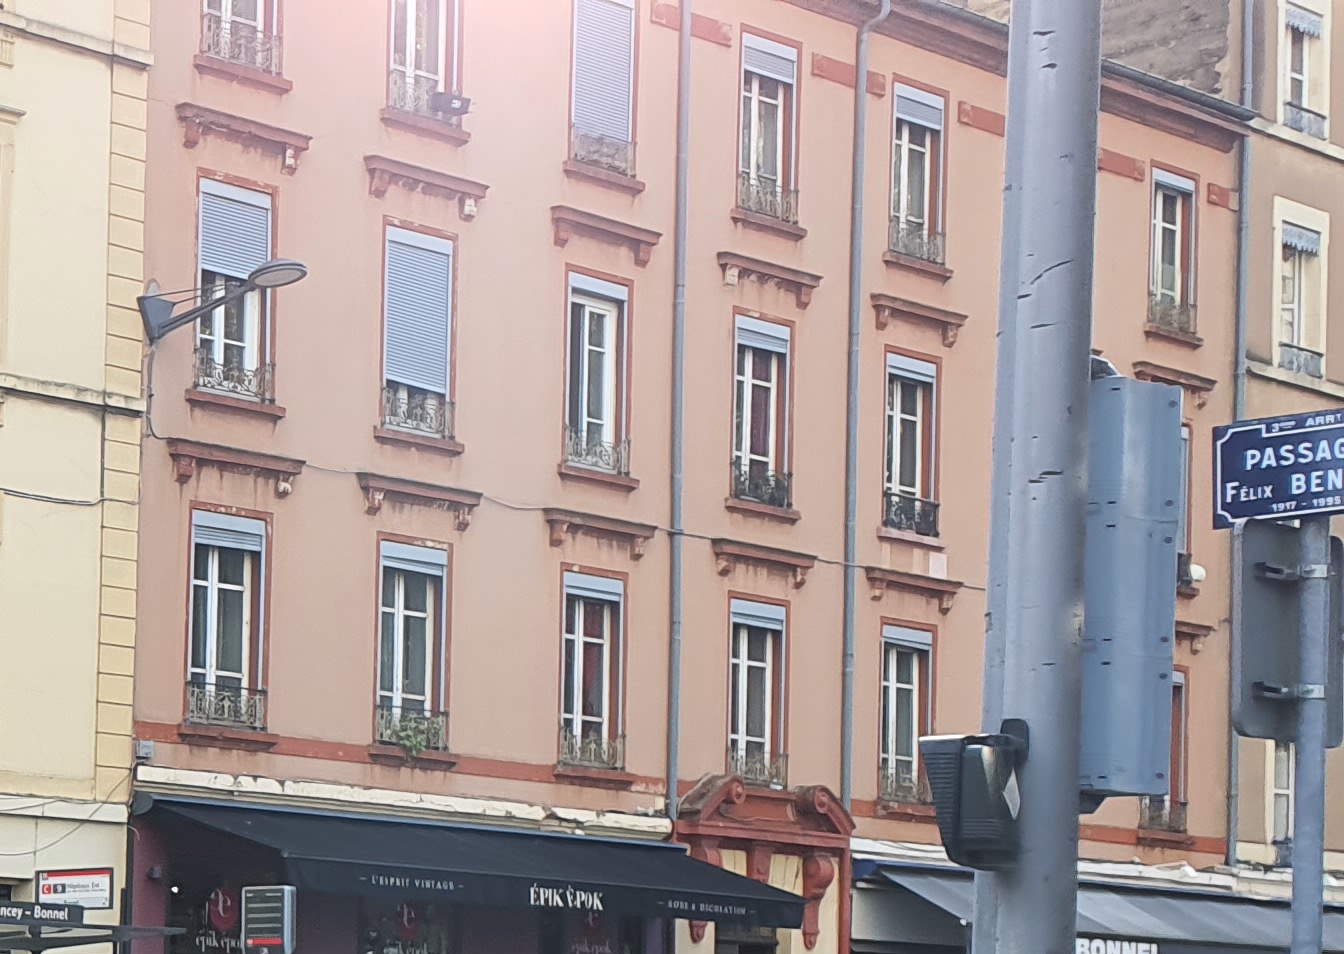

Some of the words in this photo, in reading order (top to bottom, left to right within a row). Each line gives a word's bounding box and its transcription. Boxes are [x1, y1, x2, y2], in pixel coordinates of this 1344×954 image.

[1291, 468, 1344, 495] BEN
[1272, 501, 1297, 512] 1917
[1312, 496, 1341, 507] 1995
[529, 882, 565, 909] ÉPIK
[34, 904, 68, 921] Bonnel
